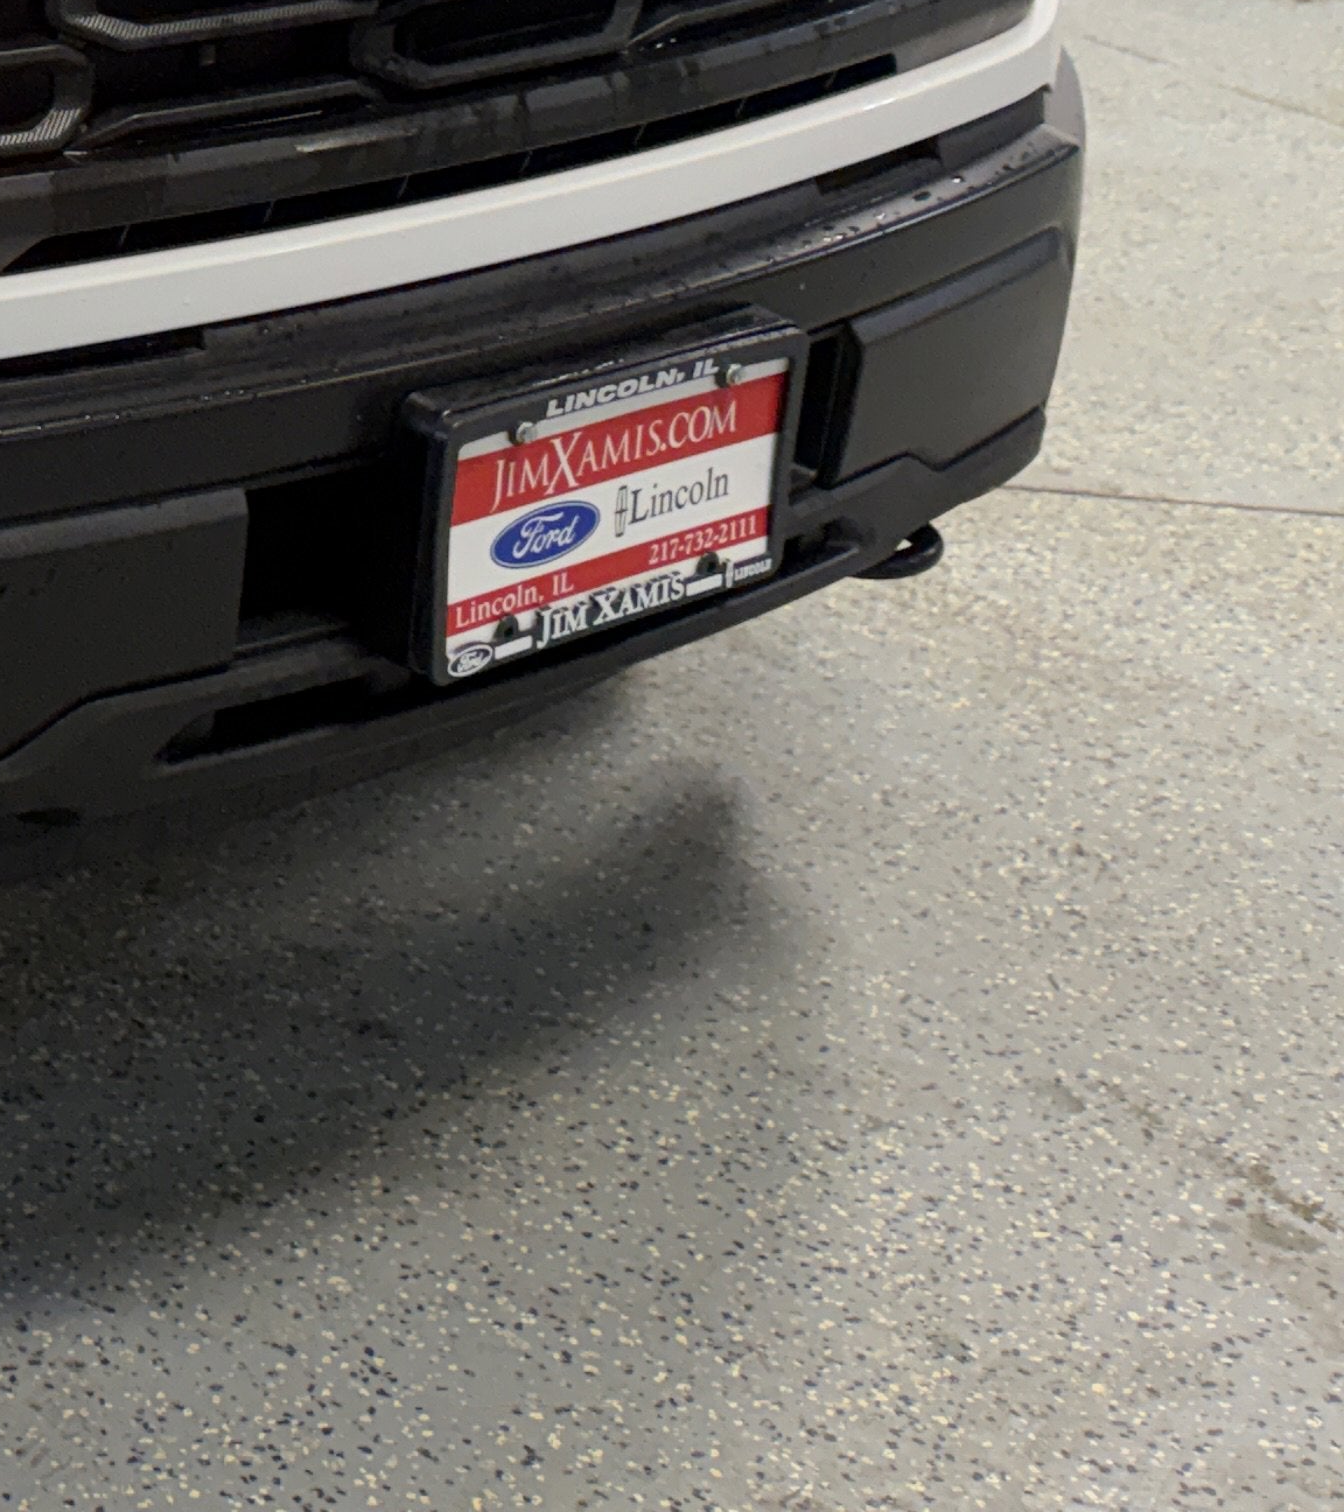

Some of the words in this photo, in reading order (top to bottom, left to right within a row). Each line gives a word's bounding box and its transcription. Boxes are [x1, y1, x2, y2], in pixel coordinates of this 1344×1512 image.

[546, 367, 686, 418] LINCOLN,
[692, 358, 720, 377] IL
[629, 466, 730, 526] Lincoln
[512, 510, 581, 560] Ford
[648, 514, 758, 566] 217-732-2111
[536, 607, 589, 649] JIM
[597, 574, 685, 621] XAMIS
[552, 572, 575, 595] IL
